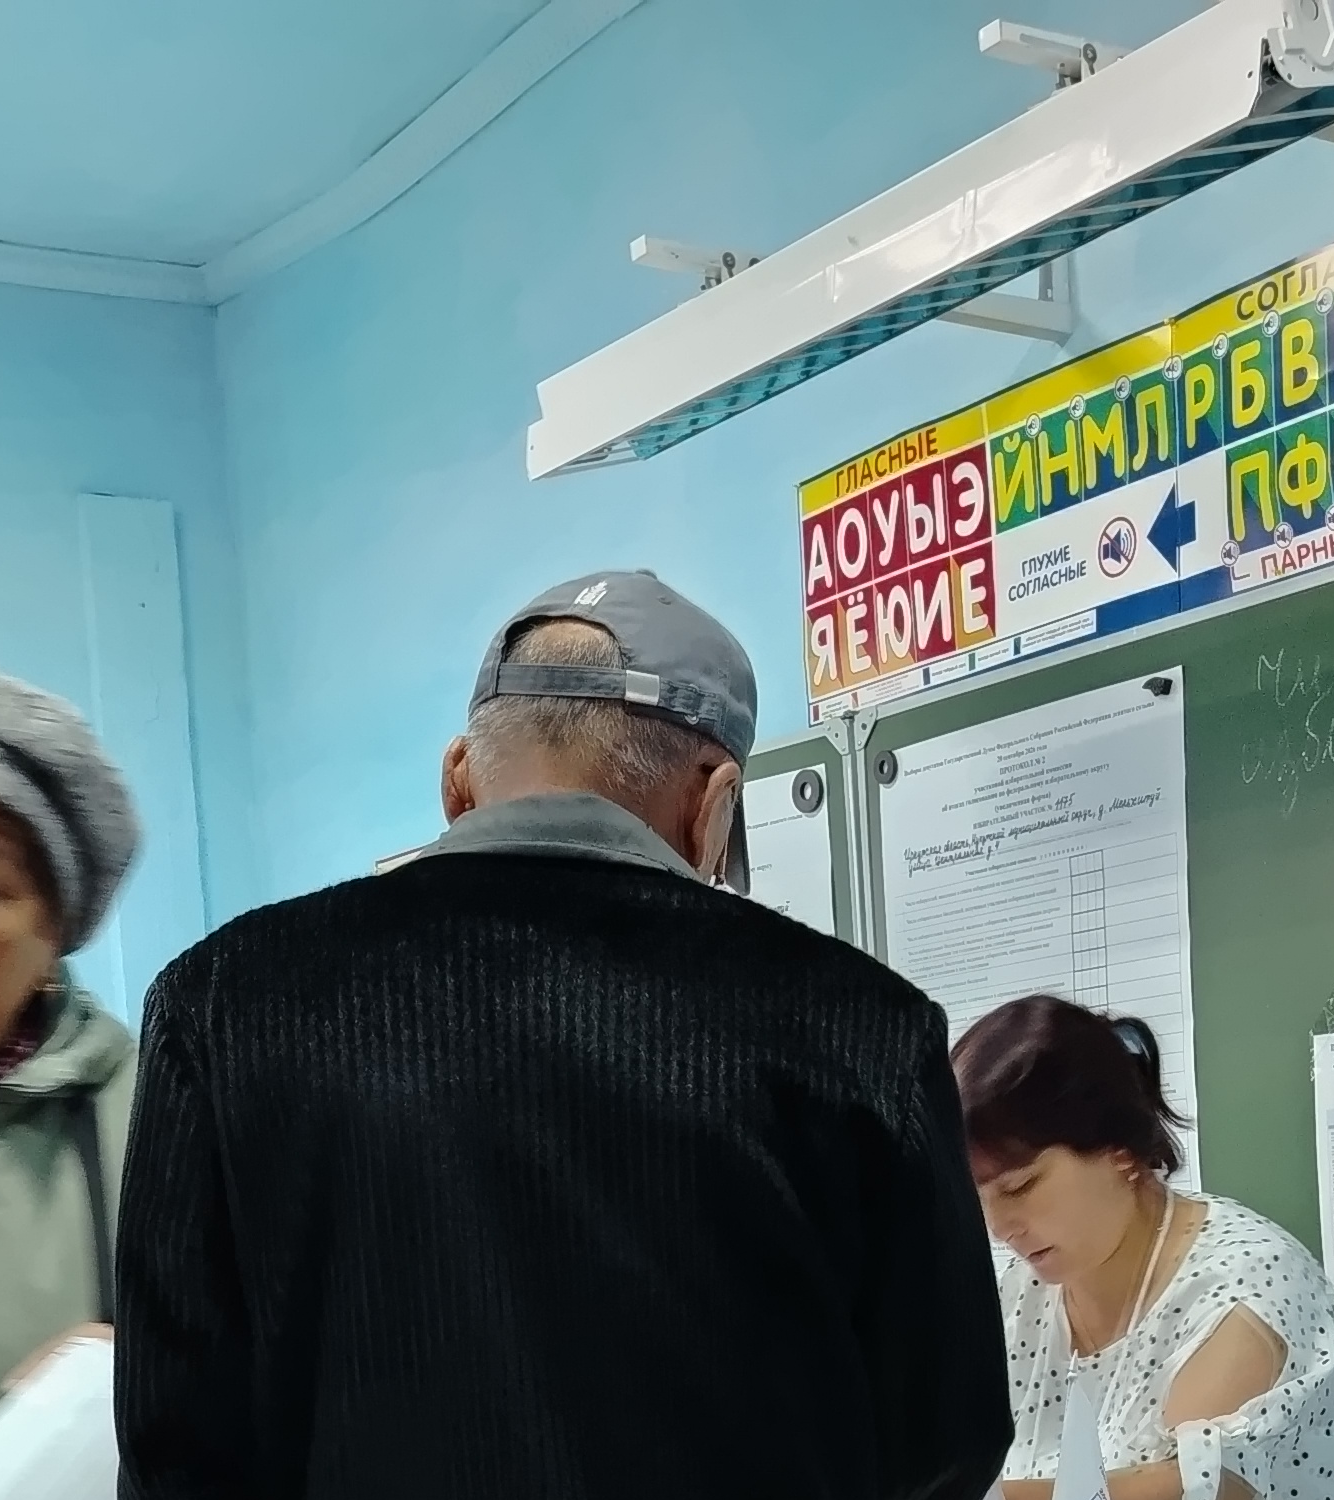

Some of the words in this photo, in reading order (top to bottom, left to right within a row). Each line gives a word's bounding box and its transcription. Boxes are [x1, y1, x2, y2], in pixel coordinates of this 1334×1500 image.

[835, 427, 939, 497] ГЛАСНЫЕ
[1007, 560, 1088, 603] СОГЛАСНЫЕ
[1020, 545, 1071, 578] ГЛУХИЕ
